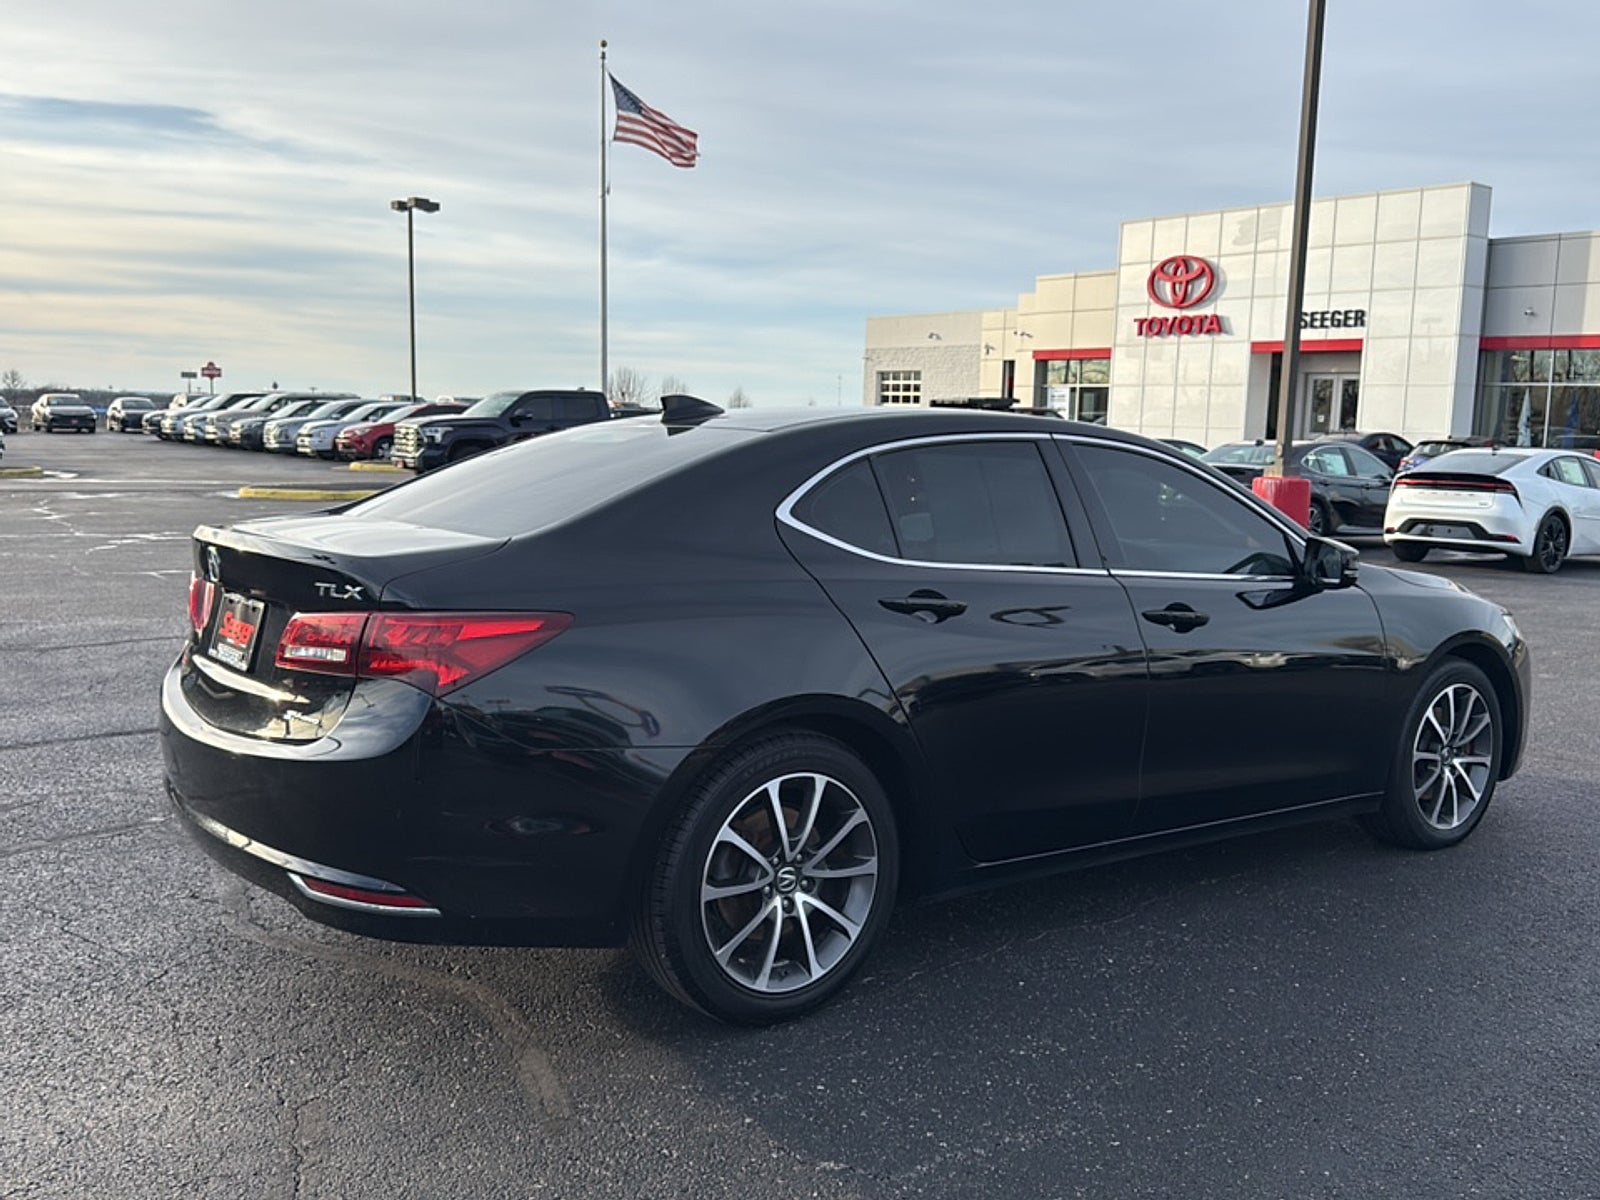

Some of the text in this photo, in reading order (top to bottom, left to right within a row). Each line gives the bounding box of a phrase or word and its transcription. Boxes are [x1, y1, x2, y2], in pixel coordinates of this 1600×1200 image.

[1134, 314, 1222, 337] TOYOTA
[1300, 310, 1366, 330] SEEGER
[313, 581, 364, 600] TLX
